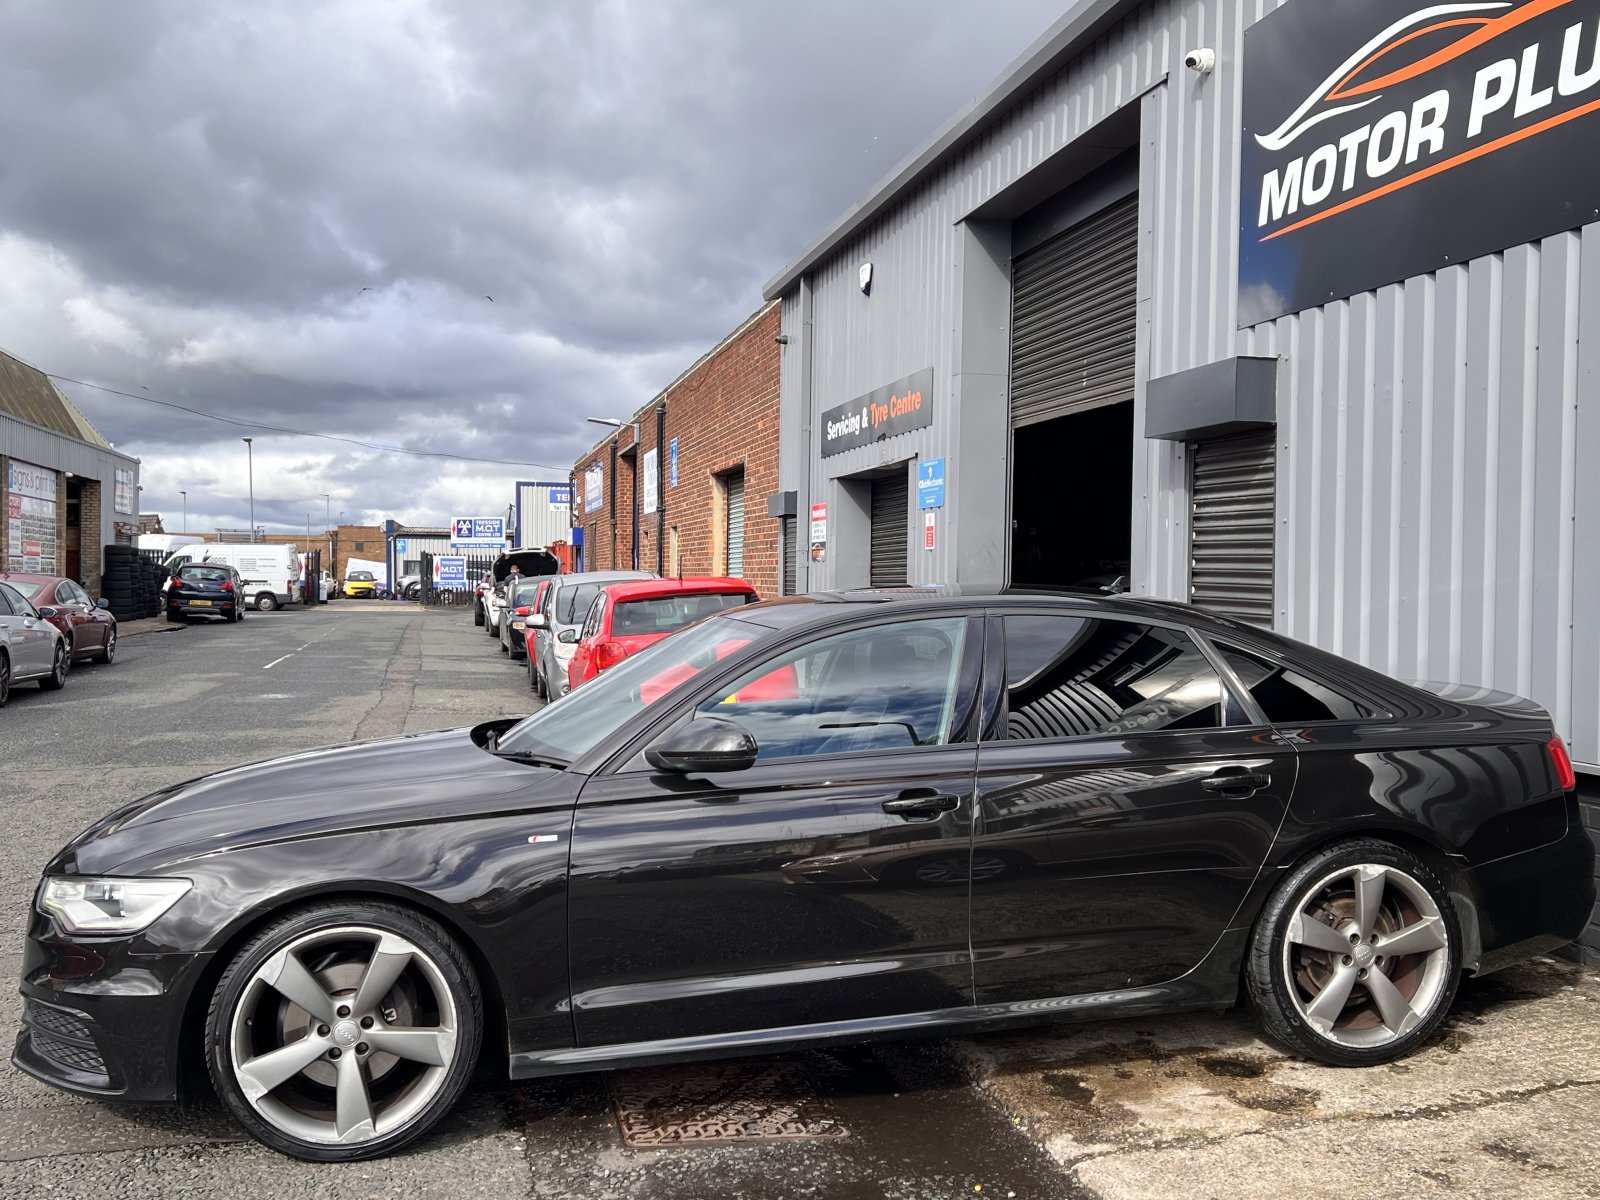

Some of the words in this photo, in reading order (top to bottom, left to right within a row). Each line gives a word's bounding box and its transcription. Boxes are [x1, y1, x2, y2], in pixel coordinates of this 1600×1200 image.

[1258, 90, 1450, 227] MOTOR
[827, 412, 860, 440] Servicing
[862, 407, 868, 428] &
[870, 403, 888, 428] Tyre
[890, 390, 921, 417] Centre
[13, 470, 29, 491] signs
